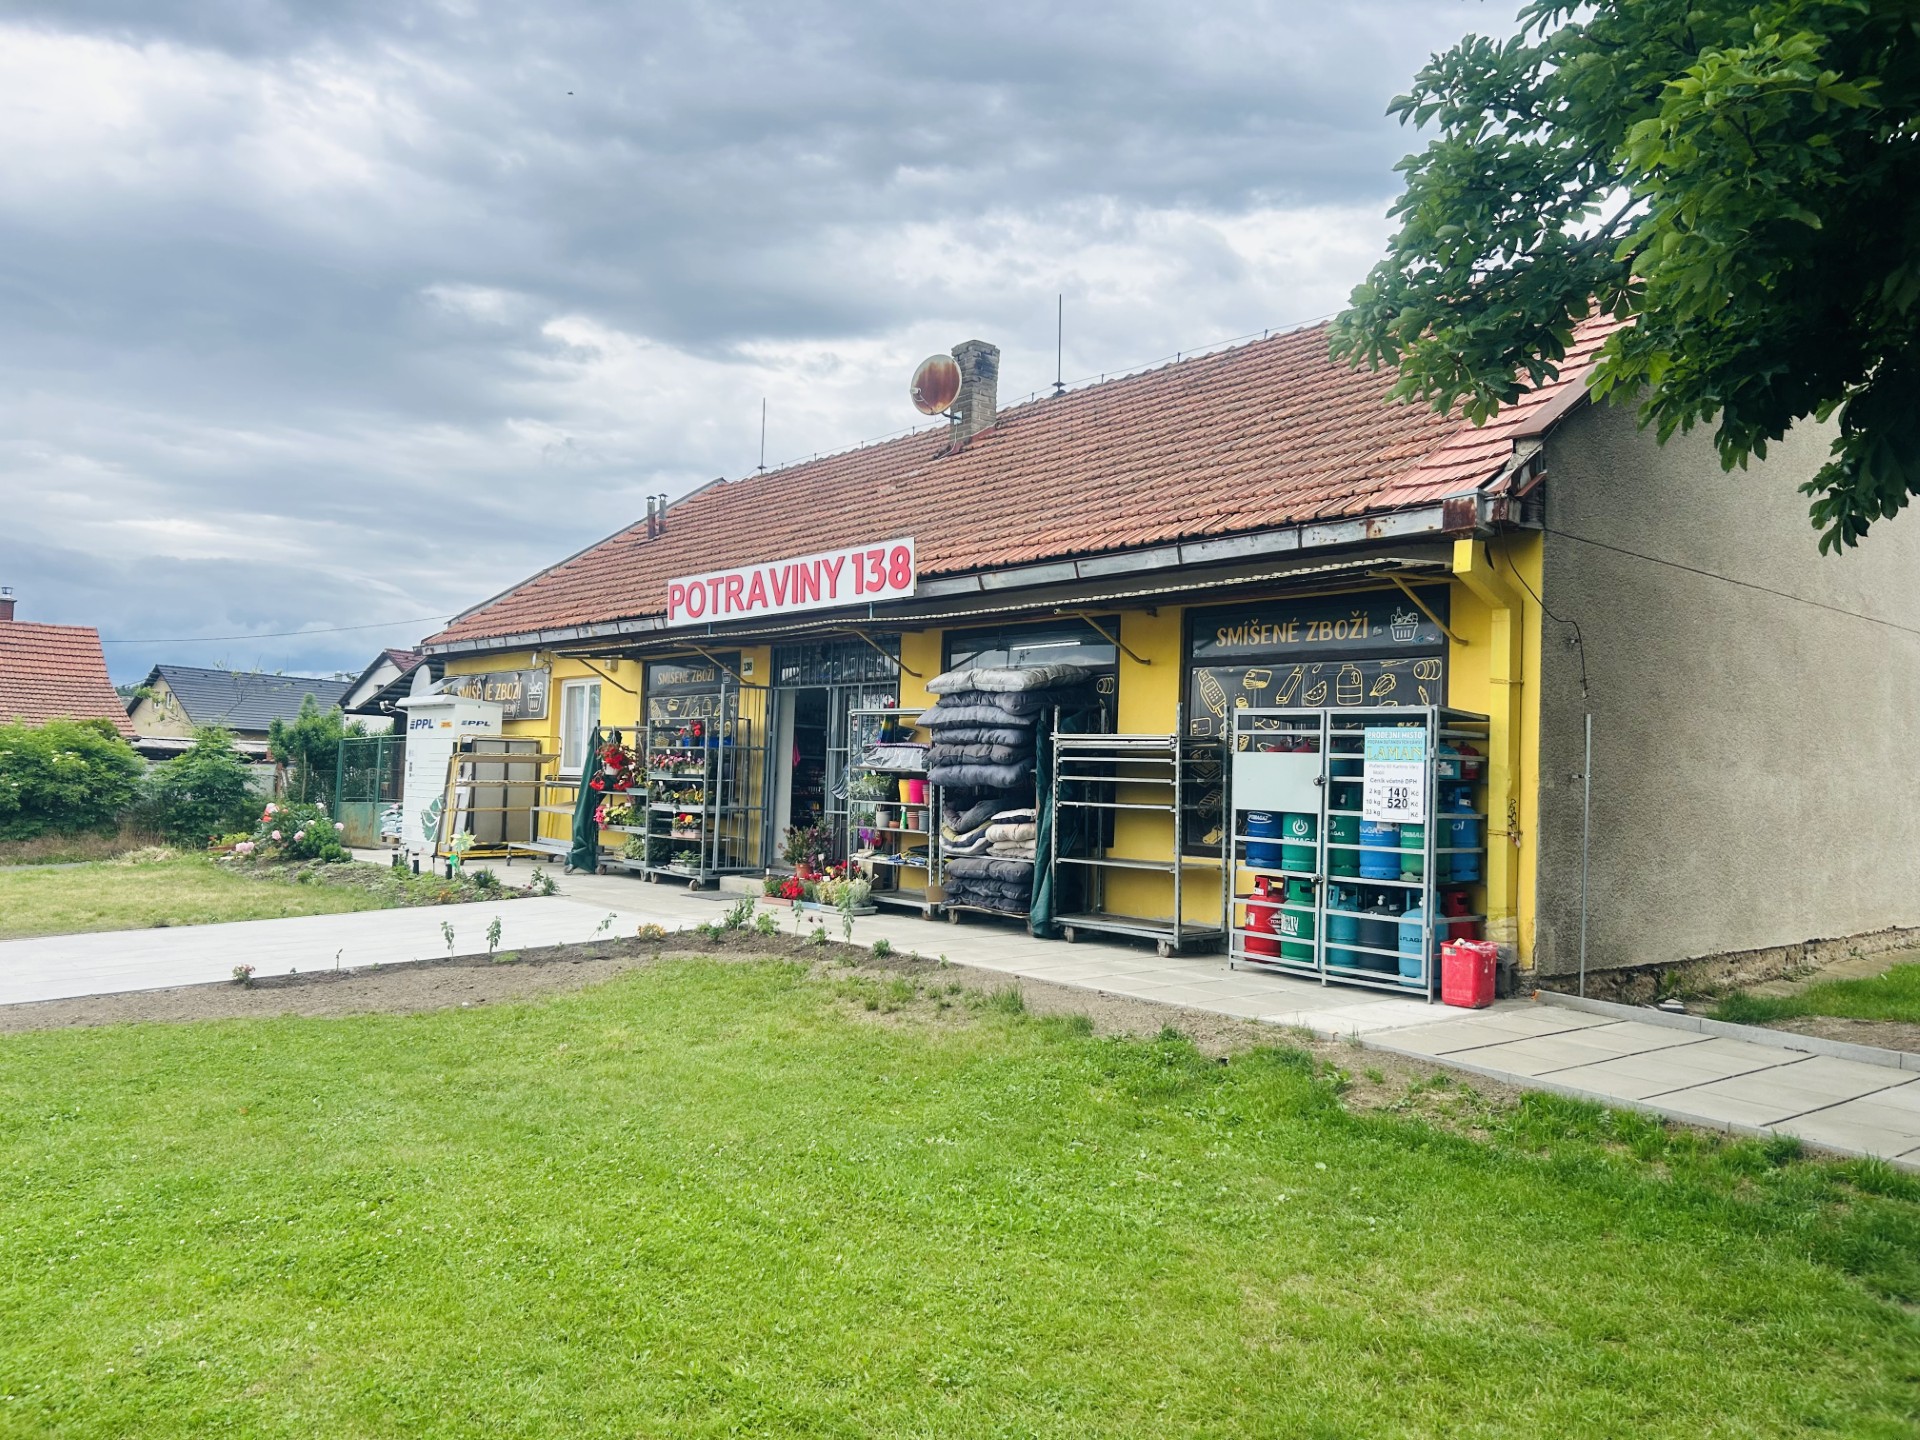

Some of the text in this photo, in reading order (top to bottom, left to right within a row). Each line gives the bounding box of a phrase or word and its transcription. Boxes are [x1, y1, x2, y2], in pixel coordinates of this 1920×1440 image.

[668, 545, 912, 621] POTRAVINY 138
[1215, 609, 1369, 647] SMÍŠENÉ ZBOŽÍ
[494, 675, 523, 701] ZBOŽÍ
[415, 718, 434, 730] PPL
[1366, 745, 1423, 760] LAMAN
[1373, 788, 1381, 796] kg
[1388, 787, 1408, 798] 140
[1373, 799, 1381, 807] kg
[1387, 798, 1408, 809] 520
[1373, 809, 1381, 817] kg
